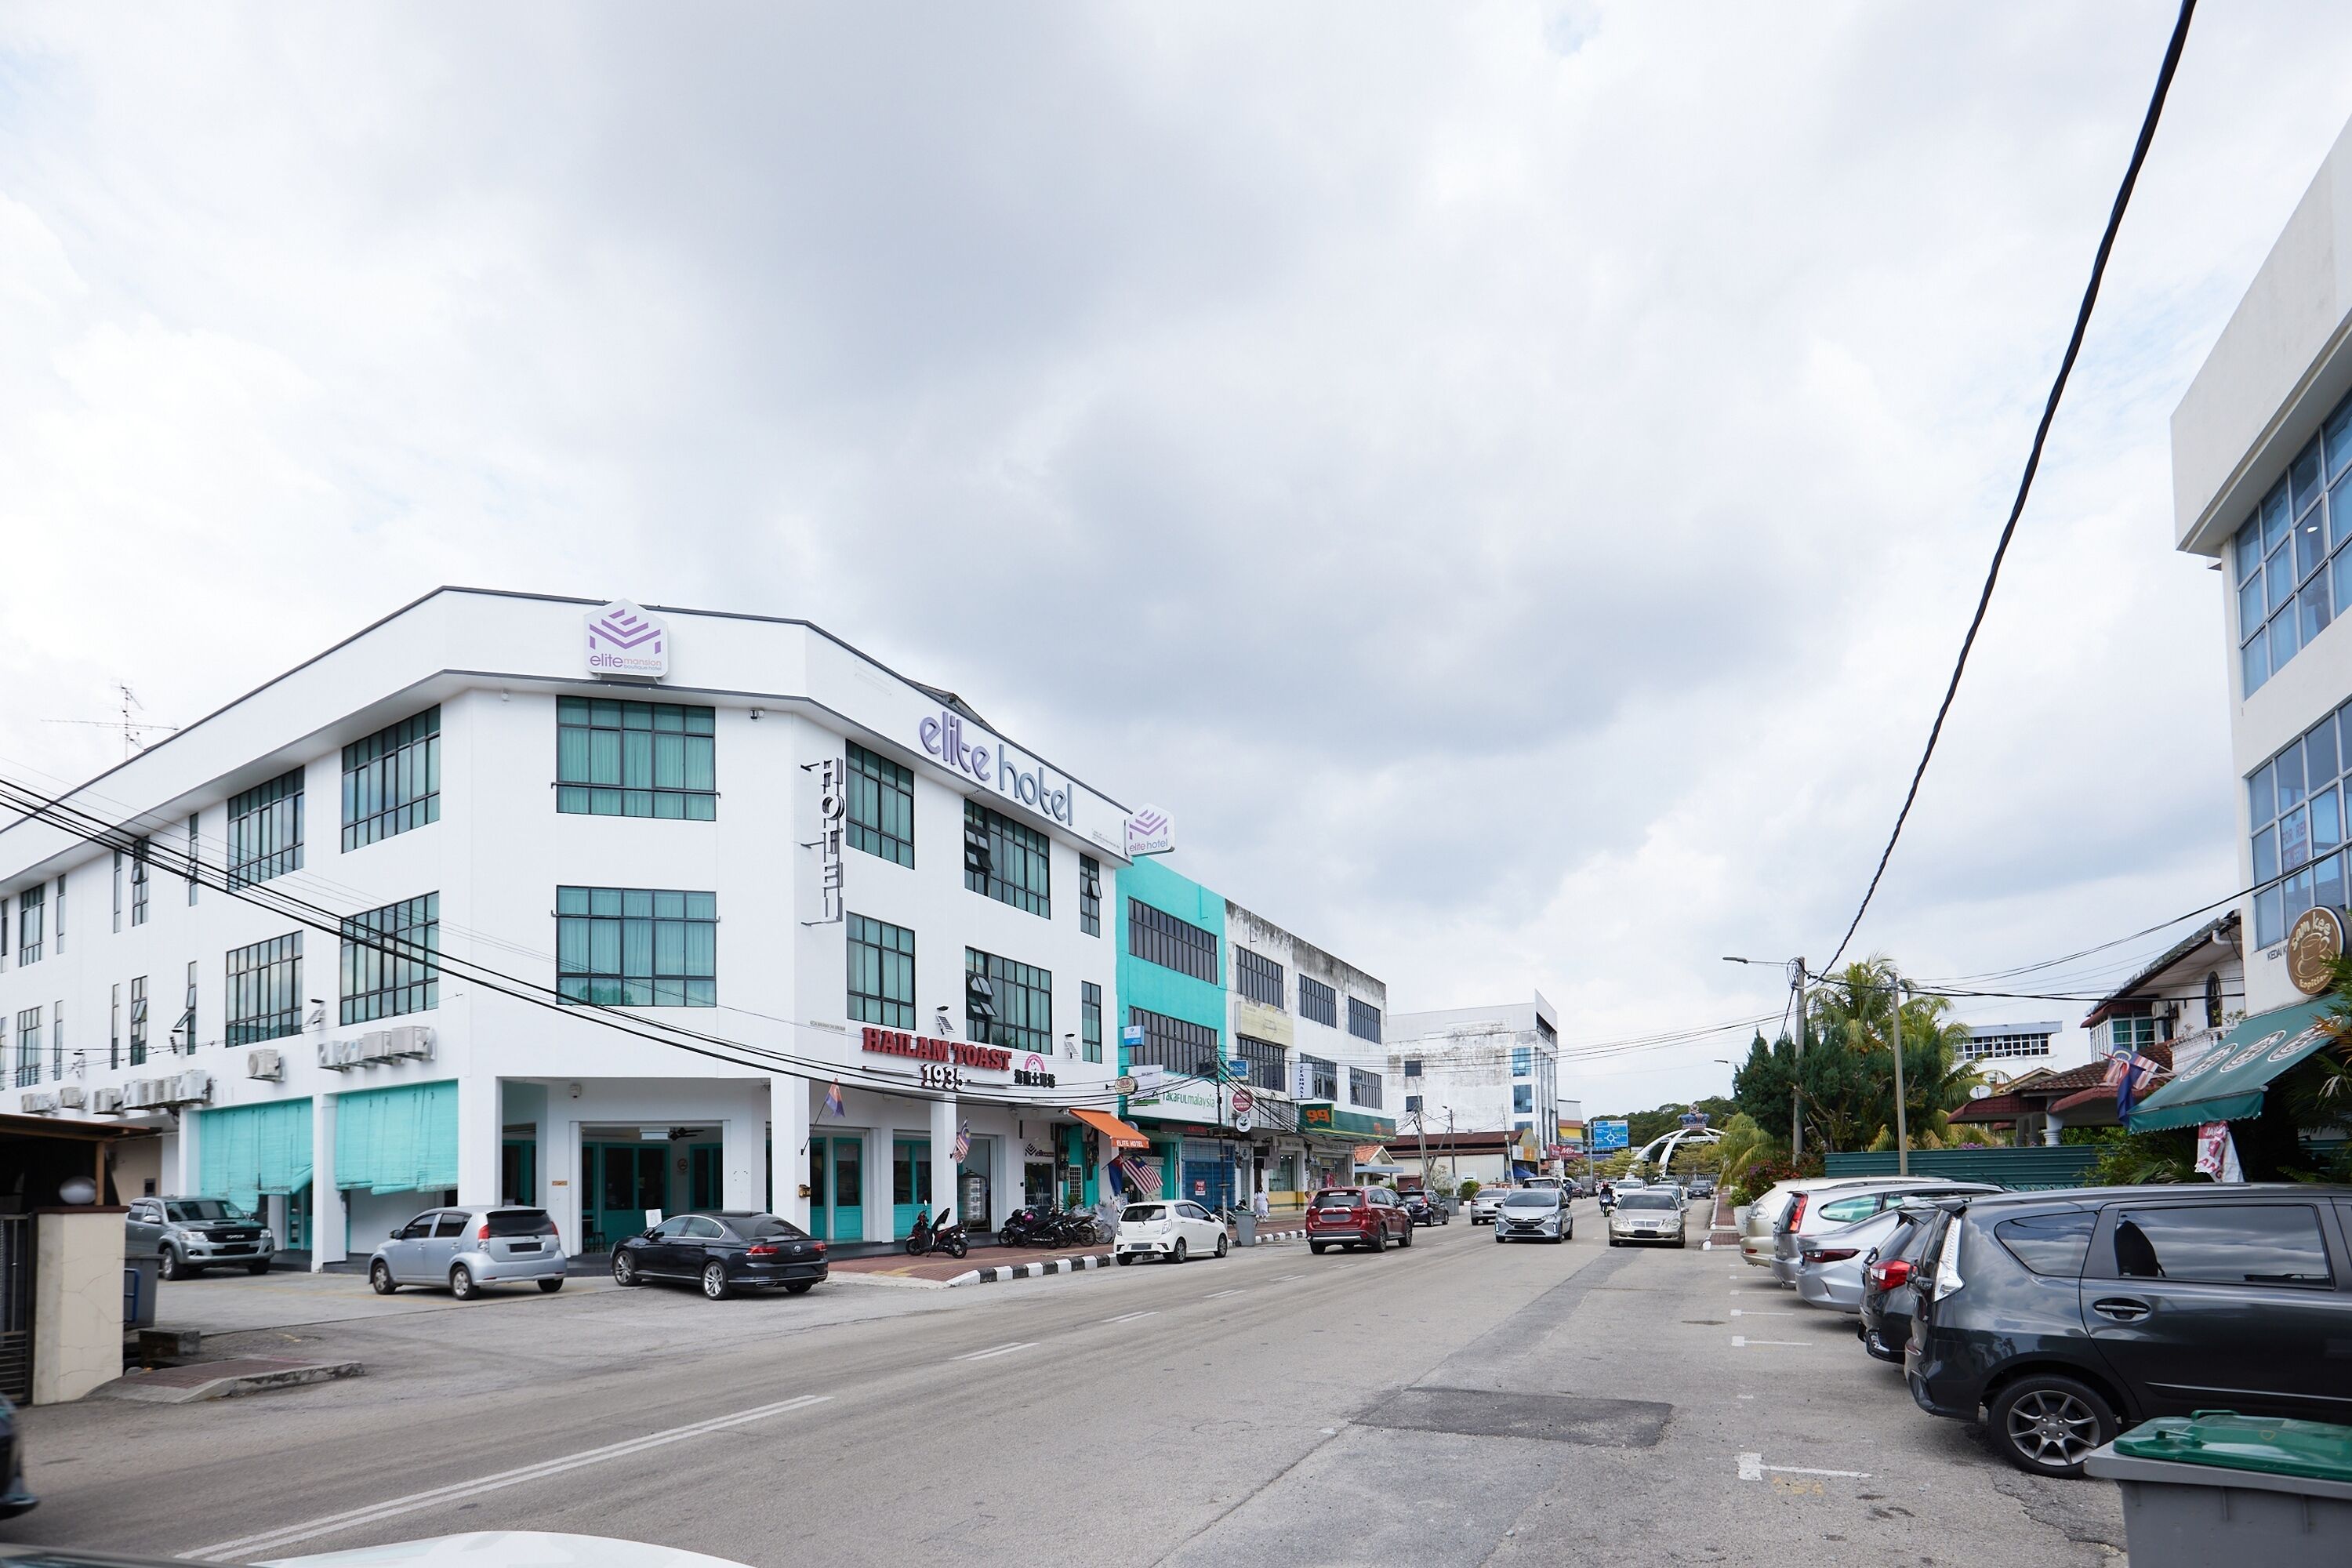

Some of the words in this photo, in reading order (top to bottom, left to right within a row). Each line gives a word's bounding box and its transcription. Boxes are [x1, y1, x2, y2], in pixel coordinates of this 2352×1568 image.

[590, 653, 623, 667] elite
[624, 658, 662, 666] mansion
[919, 711, 991, 782] elite
[999, 743, 1073, 826] hotel
[822, 757, 845, 923] HOTEL
[1129, 842, 1145, 851] elite
[1146, 839, 1168, 849] hotel
[2312, 911, 2332, 936] kee
[2267, 949, 2282, 962] KEDAI
[862, 1027, 949, 1062] HAILAM
[951, 1042, 1012, 1071] TOAST
[920, 1063, 966, 1091] 1935
[1305, 1109, 1330, 1123] 99
